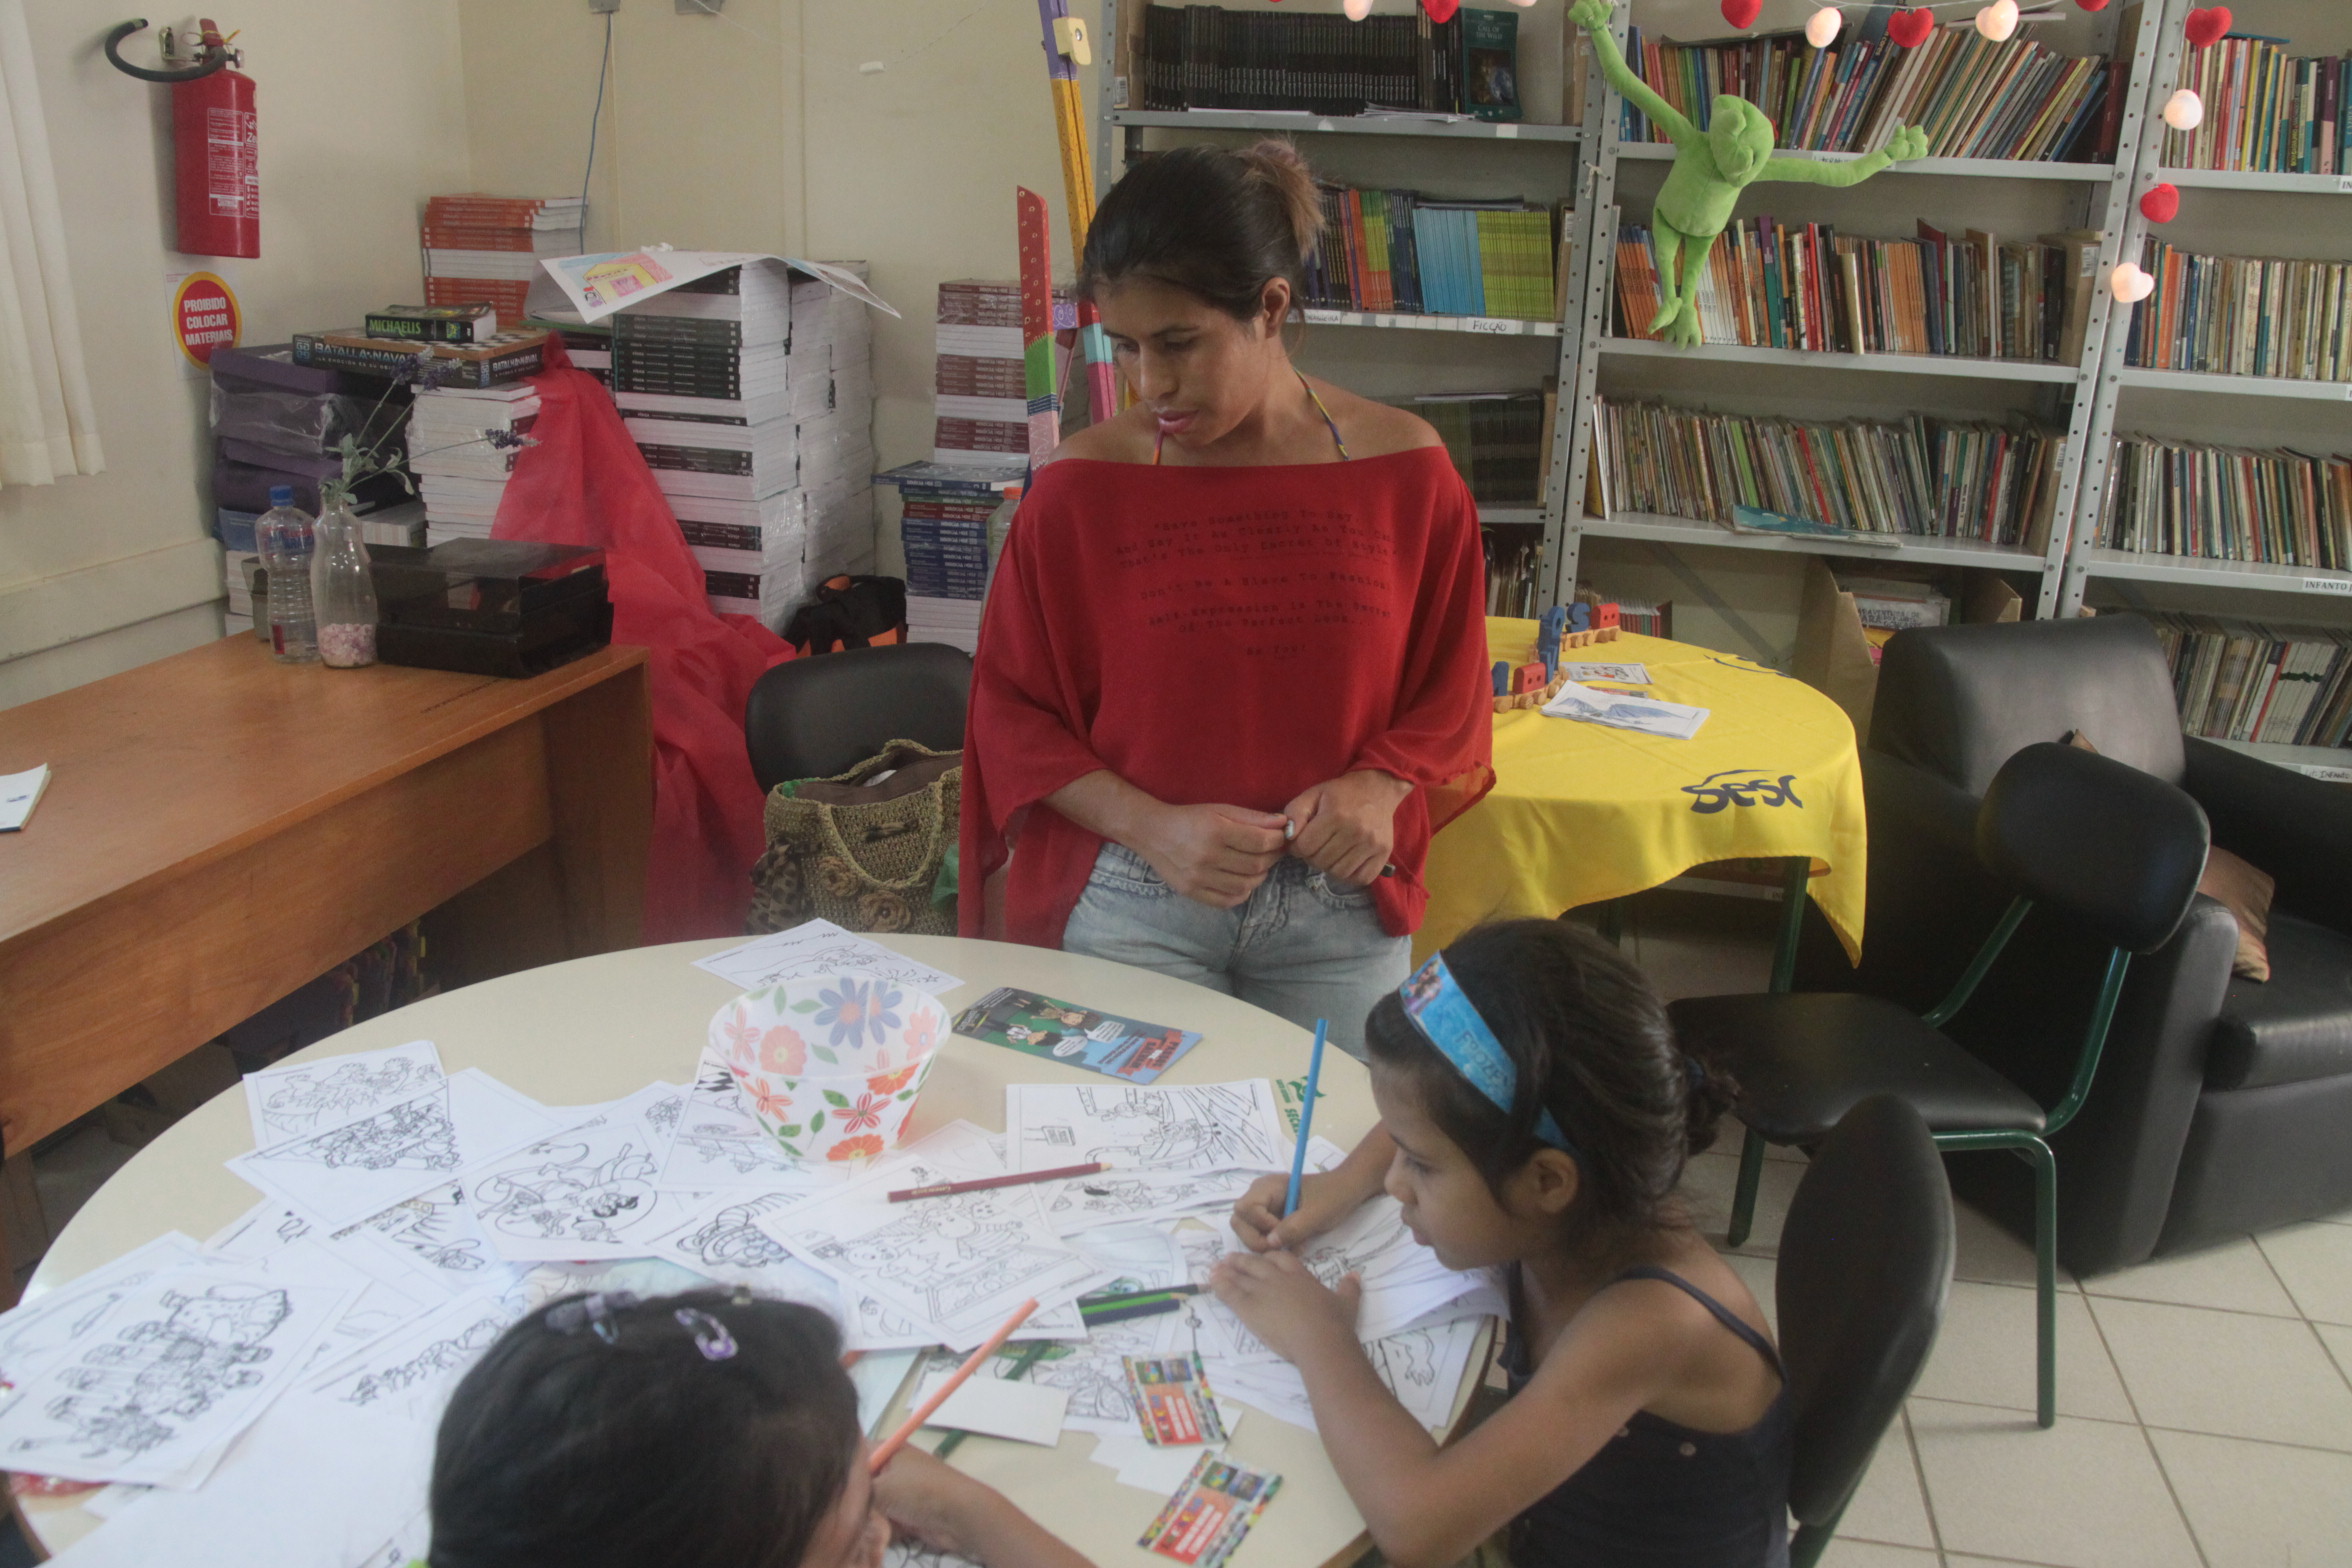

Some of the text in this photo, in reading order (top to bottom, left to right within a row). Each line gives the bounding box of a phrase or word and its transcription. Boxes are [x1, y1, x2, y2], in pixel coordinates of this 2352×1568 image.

[184, 297, 226, 313] PROIBIDO
[186, 313, 228, 329] COLOCAR
[369, 320, 420, 337] MICHAELIS
[185, 329, 233, 346] MATERIAIS
[372, 350, 408, 364] NAVA
[2305, 581, 2347, 591] INFANTO
